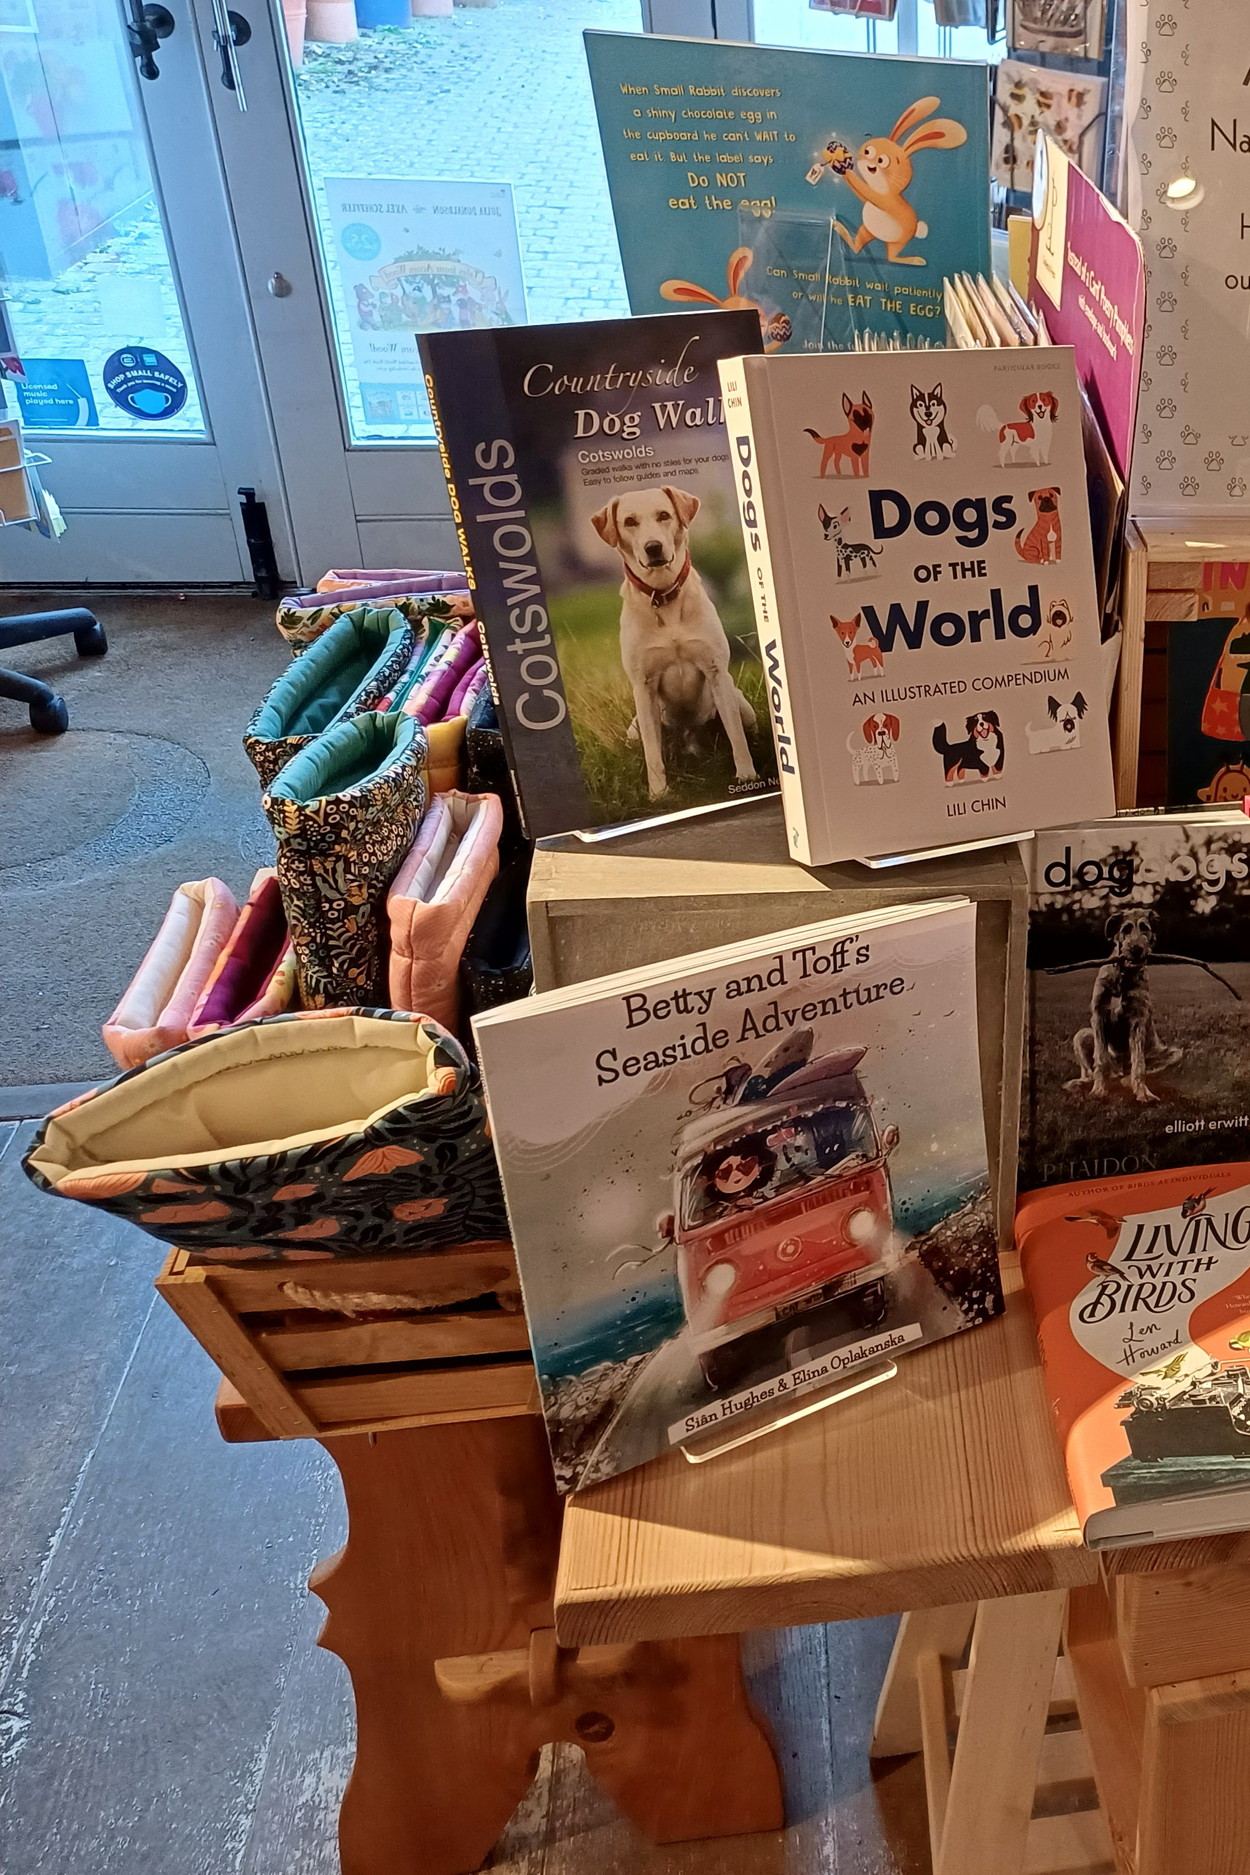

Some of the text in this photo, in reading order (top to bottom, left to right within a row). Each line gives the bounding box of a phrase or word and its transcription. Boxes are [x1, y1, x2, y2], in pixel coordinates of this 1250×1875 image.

[620, 83, 781, 98] When Small Rabbit discovers
[623, 128, 796, 145] the cupboard he can't WAIT to
[688, 172, 745, 187] Do NOT
[669, 195, 776, 218] eat the egg!
[523, 336, 699, 413] Countryside
[994, 362, 1060, 372] PARTICULAR BOOKS
[108, 374, 125, 389] SHOP
[126, 370, 152, 378] SMALL
[154, 371, 183, 389] SAFELY
[727, 381, 738, 392] LILI
[727, 397, 742, 408] CHIN
[574, 397, 724, 442] Dog Wal
[578, 445, 654, 464] Cotswolds
[867, 488, 1018, 548] Dogs
[424, 374, 500, 707] Countryside DOG WALKS Cotswolds
[913, 560, 987, 583] OF THE
[469, 439, 566, 731] Cotswolds
[735, 435, 796, 776] Dogs OF THE World
[861, 584, 1042, 653] World
[852, 668, 1070, 707] AN ILLUSTRATED COMPENDIUM
[728, 781, 766, 794] Seddon
[946, 795, 1007, 818] LILI CHIN
[621, 934, 872, 1031] Betty and Toff's
[594, 974, 907, 1087] Seaside Adventure
[1164, 1115, 1250, 1134] elliott erwitt
[1043, 1153, 1158, 1183] PHAIDON
[1068, 1187, 1109, 1197] AUTHOR
[1127, 1181, 1154, 1190] BIRDS
[1170, 1172, 1231, 1184] INDIVIDUALS
[1127, 1256, 1219, 1280] WITH
[1078, 1278, 1198, 1324] BIRDS
[1122, 1322, 1161, 1344] Len
[1115, 1329, 1183, 1366] Howard
[684, 1332, 906, 1434] Siân Hughes & Elina Oplakanska
